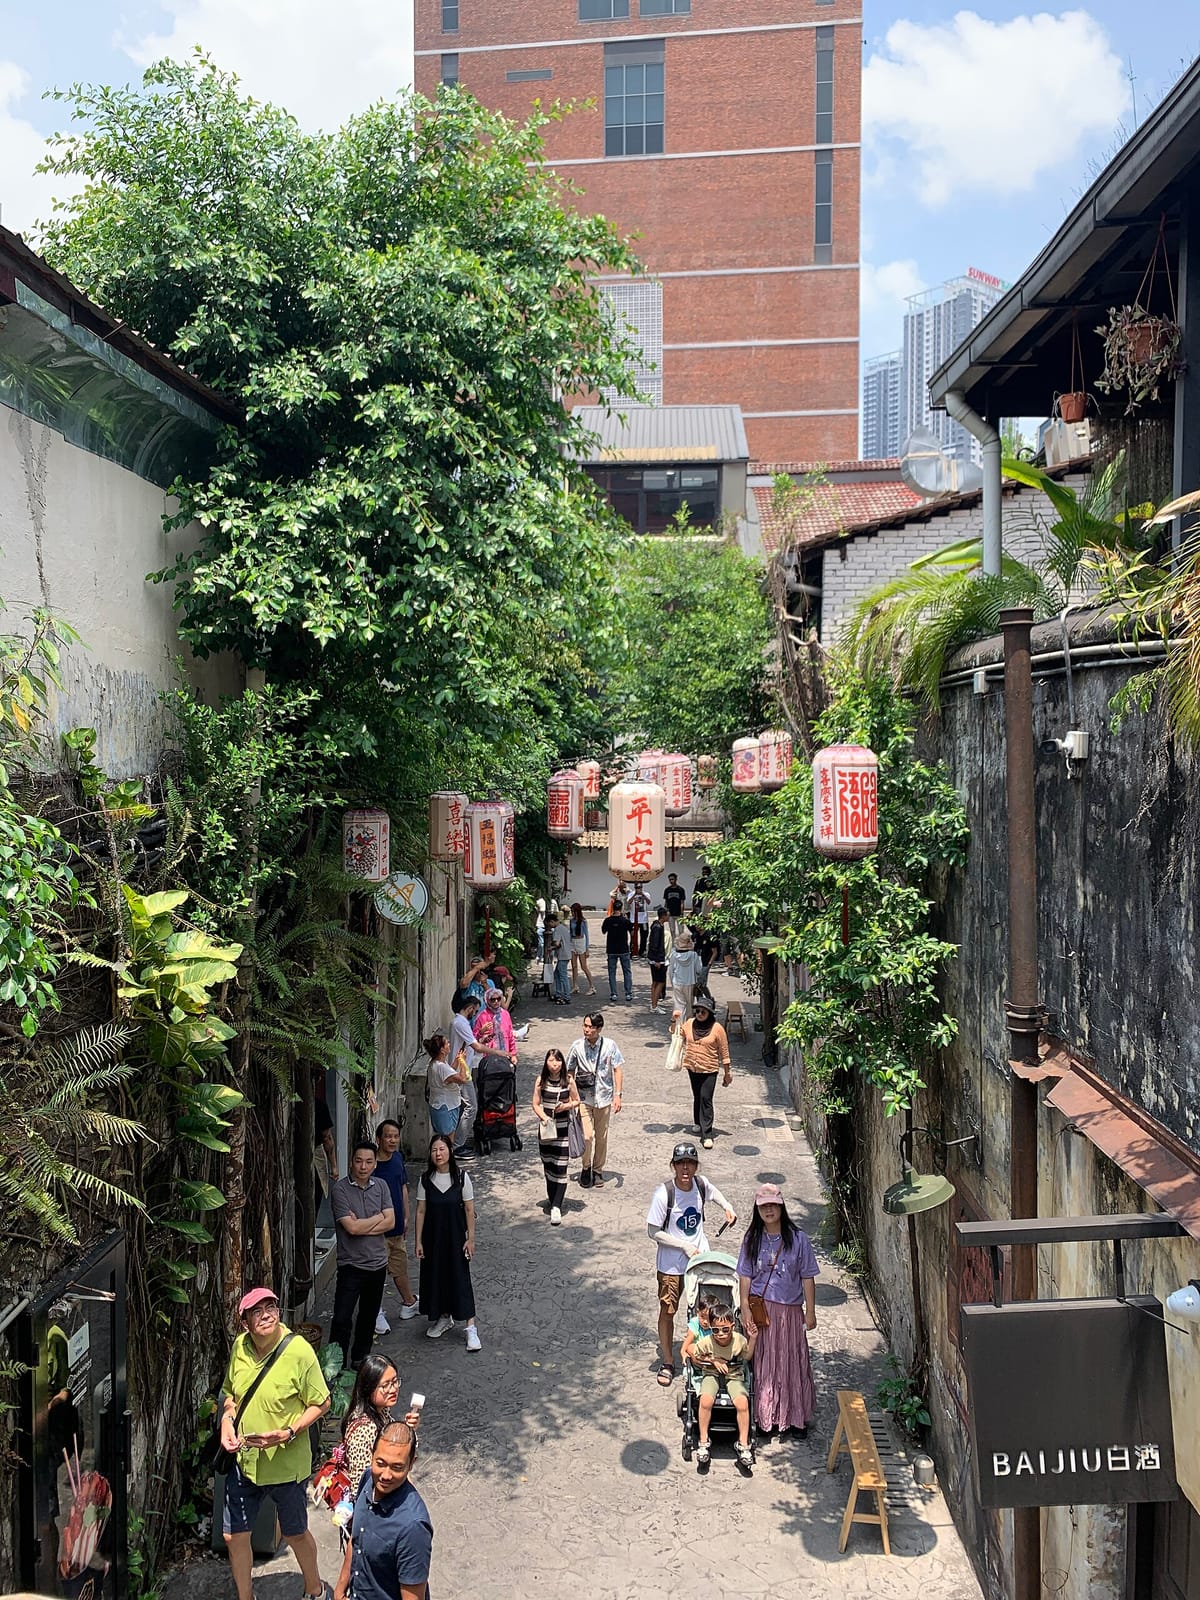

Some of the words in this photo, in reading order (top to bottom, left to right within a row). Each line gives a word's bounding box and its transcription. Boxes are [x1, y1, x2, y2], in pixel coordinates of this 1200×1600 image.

[968, 266, 1000, 288] SUNWAY
[444, 800, 465, 853] 喜樂
[480, 818, 497, 876] 五福臨門
[626, 796, 652, 871] 平安
[683, 1214, 697, 1230] 15
[993, 1448, 1102, 1477] BAIJIU
[1107, 1443, 1161, 1471] 白酒
